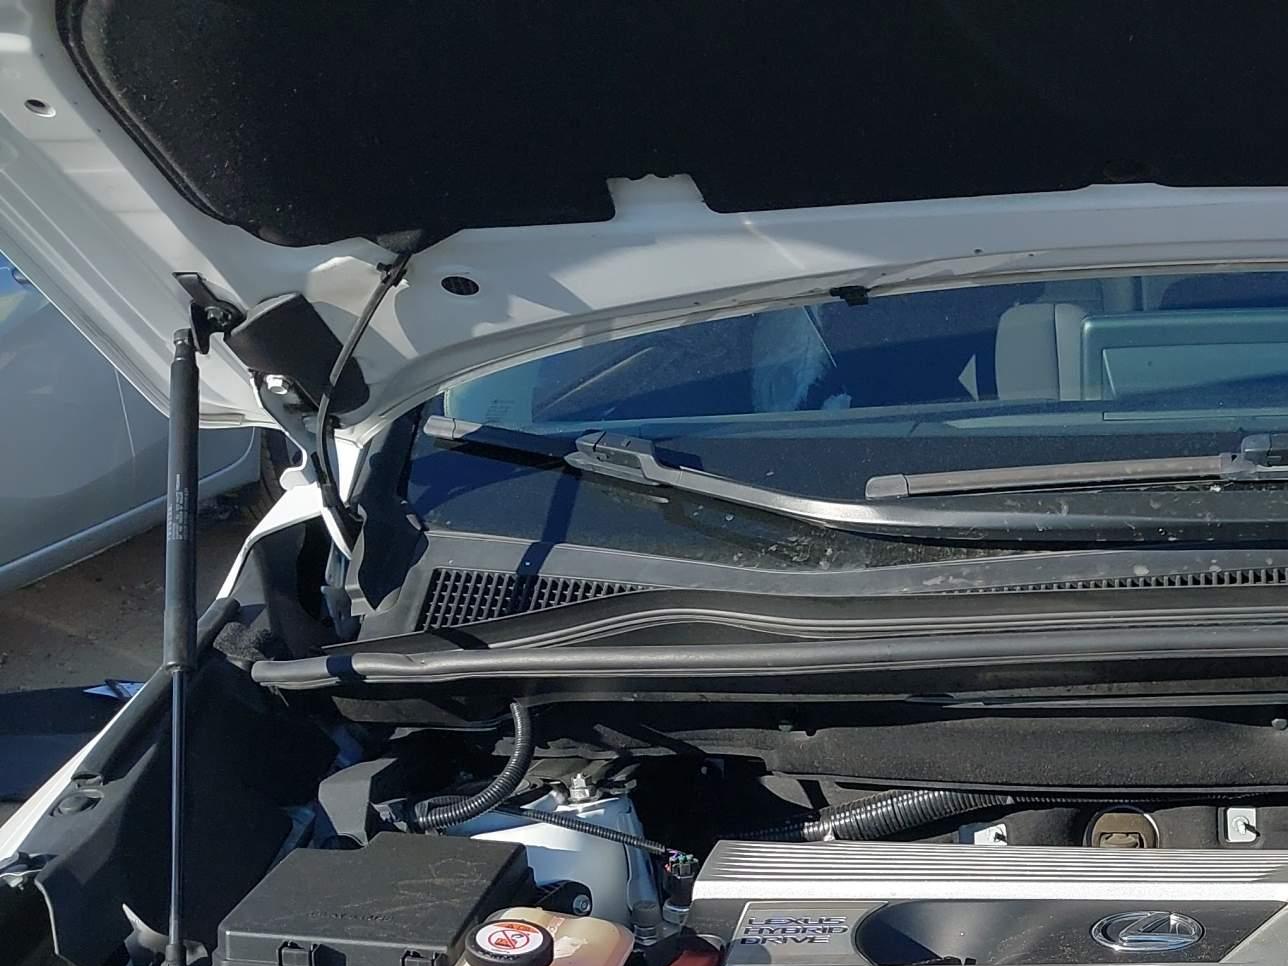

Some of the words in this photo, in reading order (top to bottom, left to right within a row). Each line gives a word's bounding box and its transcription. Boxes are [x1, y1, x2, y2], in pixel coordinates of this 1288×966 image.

[748, 916, 847, 925] LEXUS
[744, 926, 848, 935] HYBRID
[740, 935, 830, 945] DRIVE
